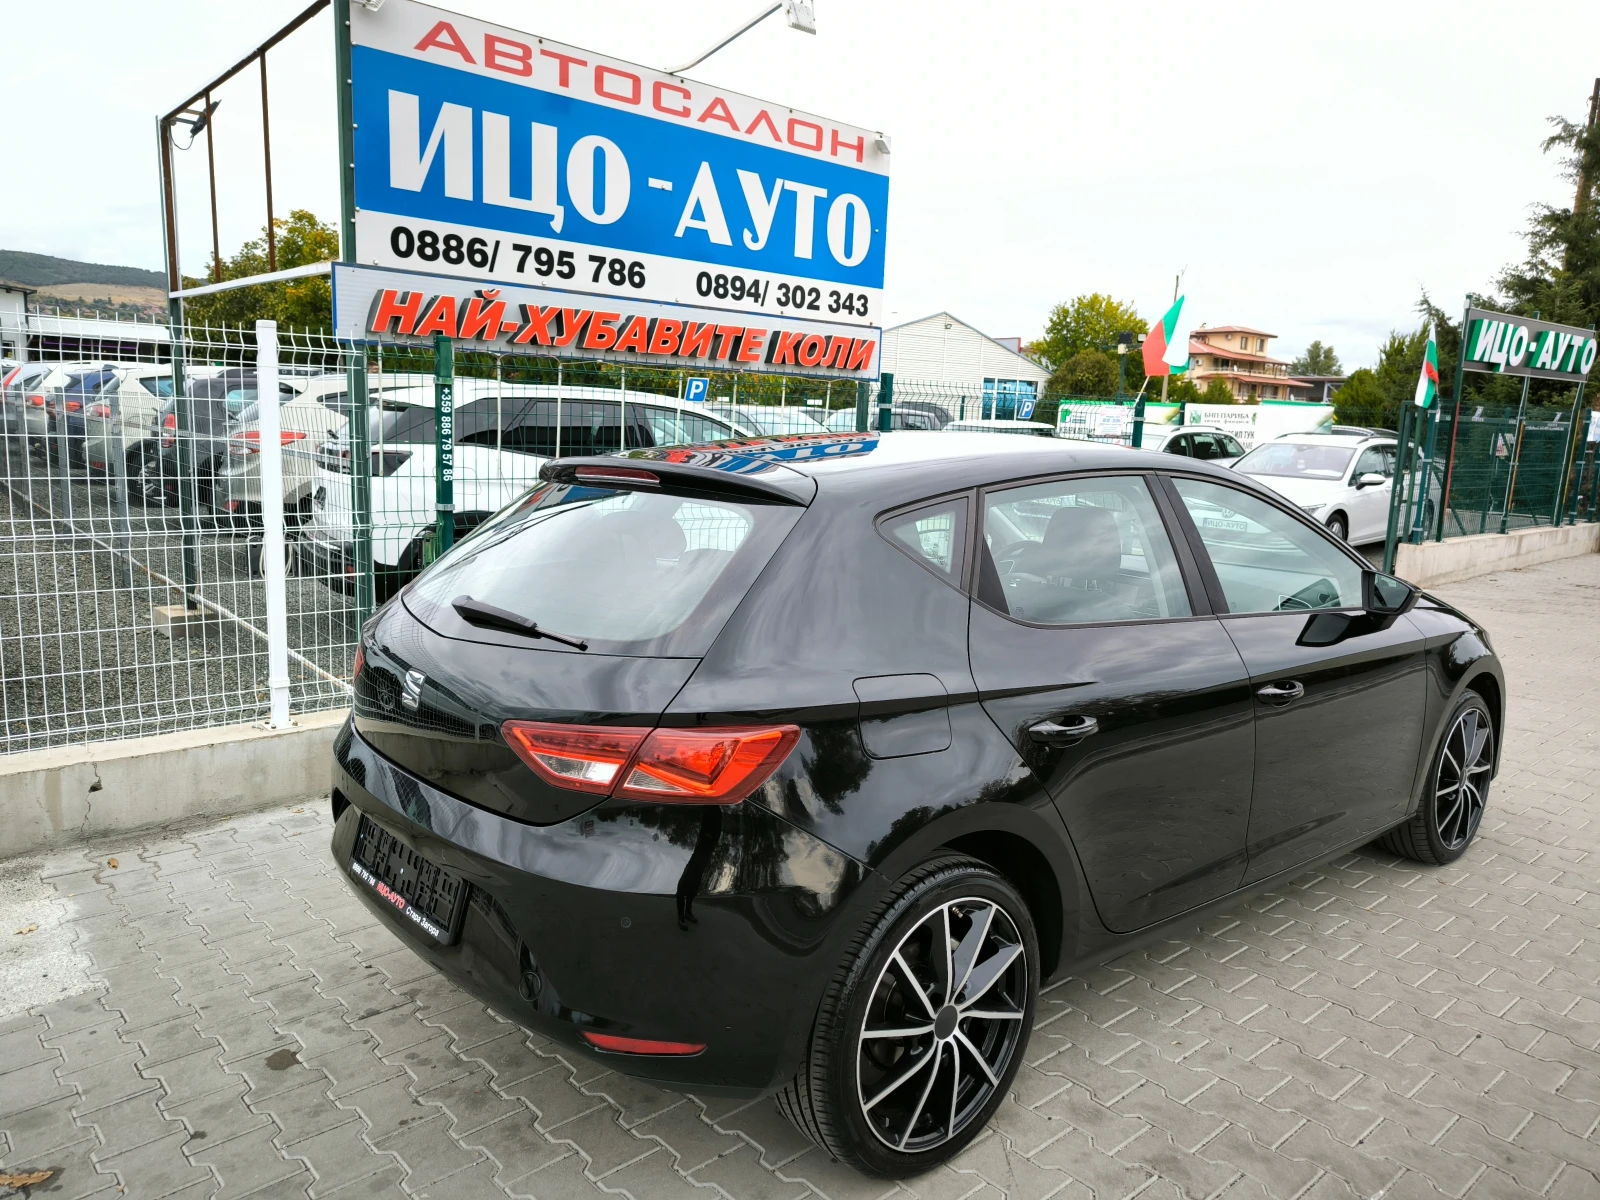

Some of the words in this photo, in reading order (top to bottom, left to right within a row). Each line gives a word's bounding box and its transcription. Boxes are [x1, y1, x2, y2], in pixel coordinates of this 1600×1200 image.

[414, 20, 864, 164] АВТОСАЛОН
[389, 225, 500, 274] 0886/
[512, 243, 577, 280] 795
[588, 253, 646, 289] 786
[695, 270, 770, 307] 0894/
[775, 281, 821, 312] 302
[828, 289, 869, 317] 343
[369, 287, 768, 363] НАЙ-ХУБАВИТЕ
[775, 331, 876, 371] КОЛИ
[1473, 318, 1598, 375] ИЦО-АУТО
[441, 387, 452, 413] +359
[441, 417, 452, 435] 886
[441, 438, 452, 451] 79
[442, 454, 453, 466] 57
[443, 469, 453, 482] 86
[1207, 520, 1245, 530] ИЦО-АУТО
[376, 881, 406, 909] ИЦО-АУТО
[405, 906, 421, 923] Стара
[420, 917, 440, 937] Загора
